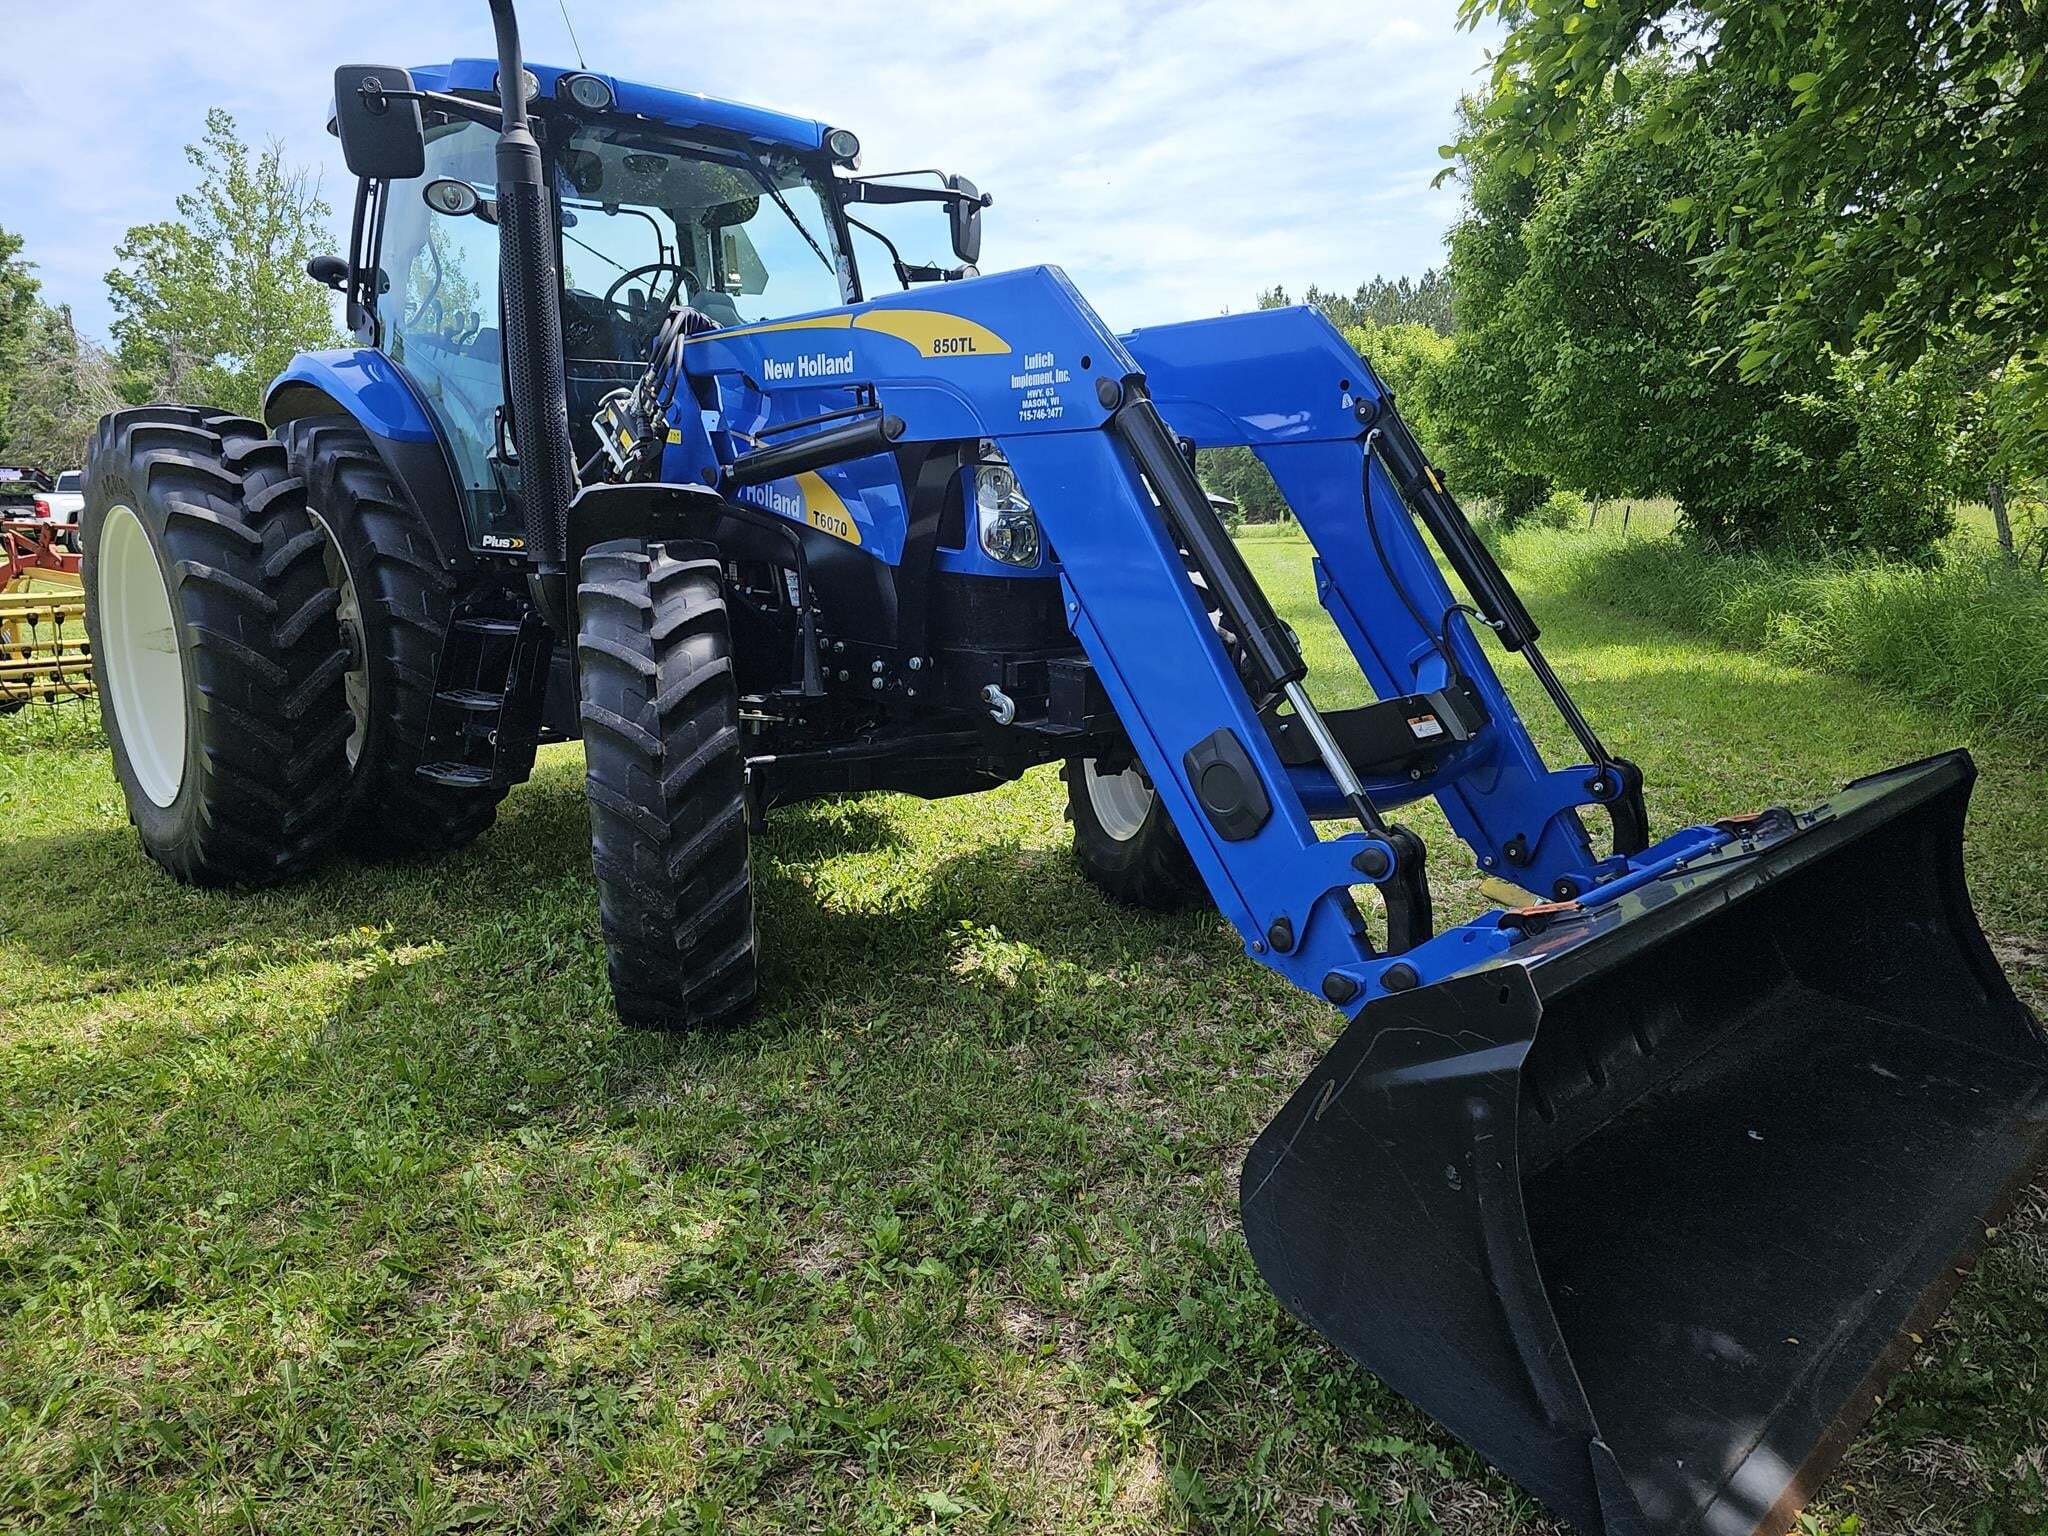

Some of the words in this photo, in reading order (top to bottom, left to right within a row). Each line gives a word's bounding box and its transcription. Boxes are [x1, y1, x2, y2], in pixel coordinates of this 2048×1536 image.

[933, 337, 976, 353] 850TL
[763, 358, 795, 380] New
[797, 350, 854, 377] Holland
[1024, 351, 1054, 370] Lulich
[1055, 368, 1071, 383] Inc.
[1045, 387, 1054, 398] 63
[1022, 397, 1049, 409] MASON,
[1050, 396, 1060, 406] WI
[813, 510, 848, 537] T6070
[482, 535, 511, 548] Plus
